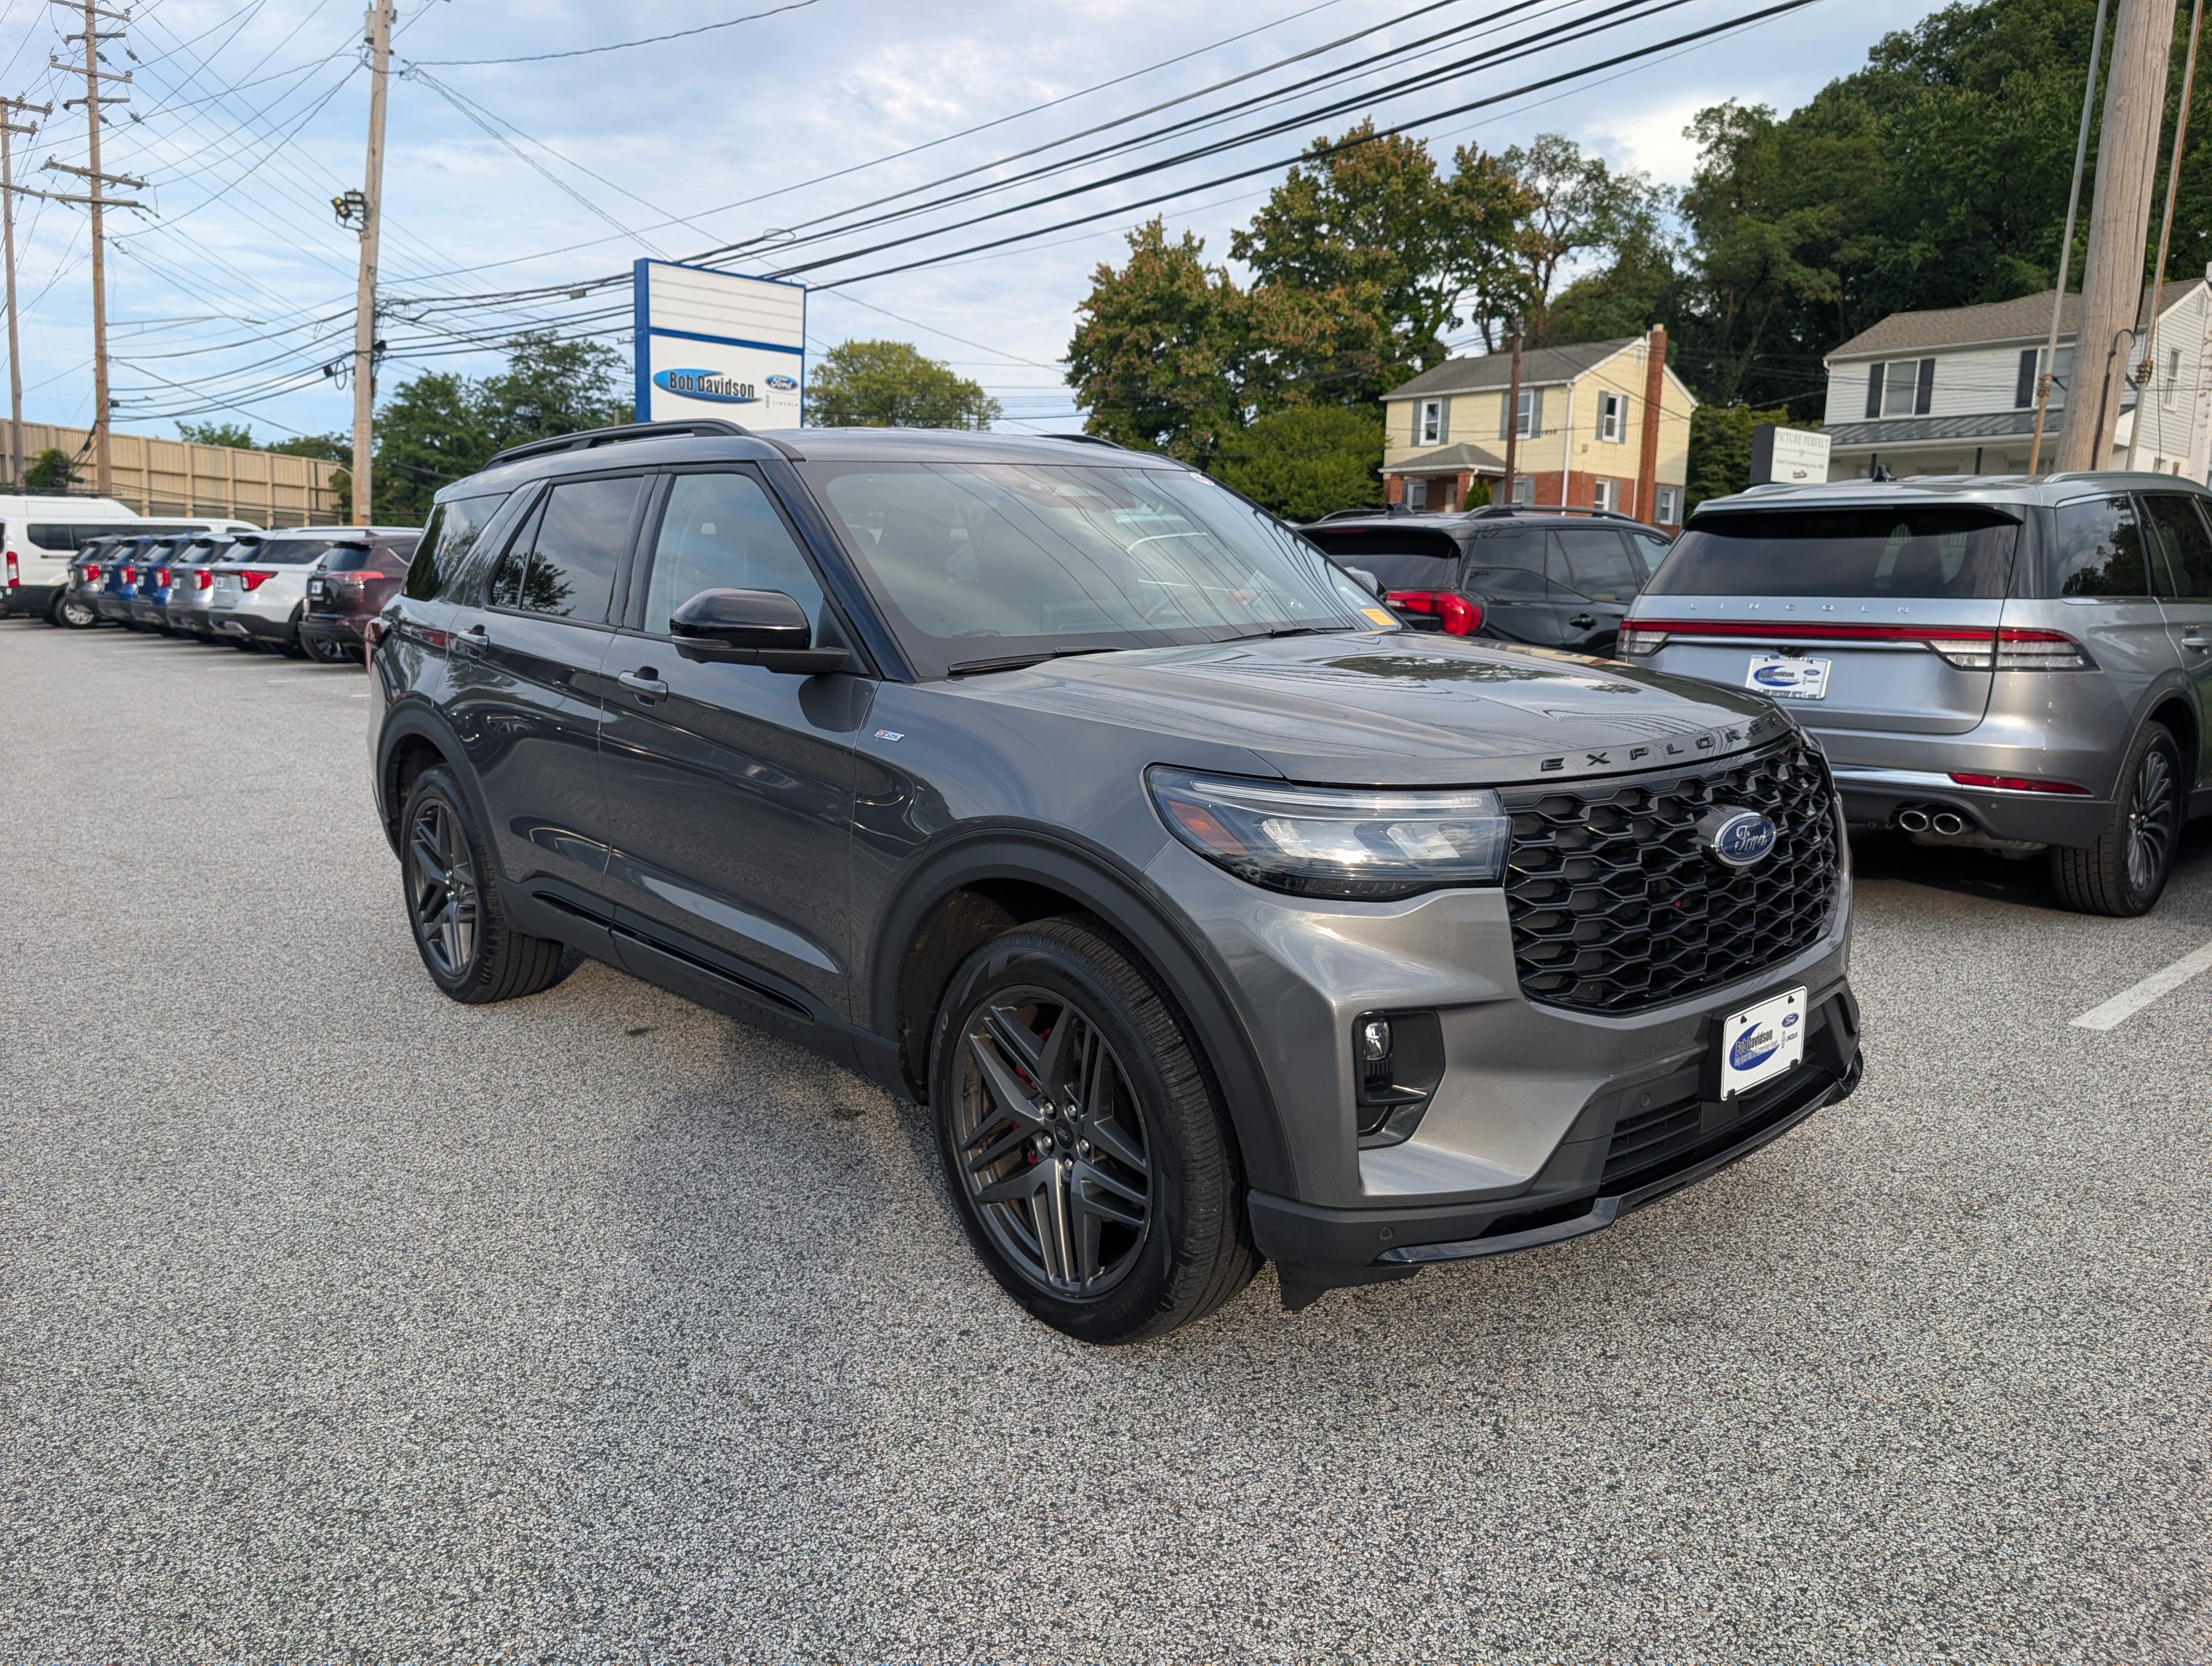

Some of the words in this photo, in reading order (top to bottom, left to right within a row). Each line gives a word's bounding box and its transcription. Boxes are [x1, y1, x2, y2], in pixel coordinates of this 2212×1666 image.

[669, 371, 693, 391] Bob
[697, 375, 755, 399] Davidson
[770, 376, 794, 389] Ford
[1774, 431, 1802, 445] PICTURE
[1803, 435, 1829, 450] PERFECT
[1689, 602, 1910, 615] LINCOLN
[1540, 714, 1783, 772] EXPLORER
[1734, 824, 1769, 855] Ford
[1735, 1038, 1747, 1056] Bob
[1747, 1029, 1773, 1050] Davidson
